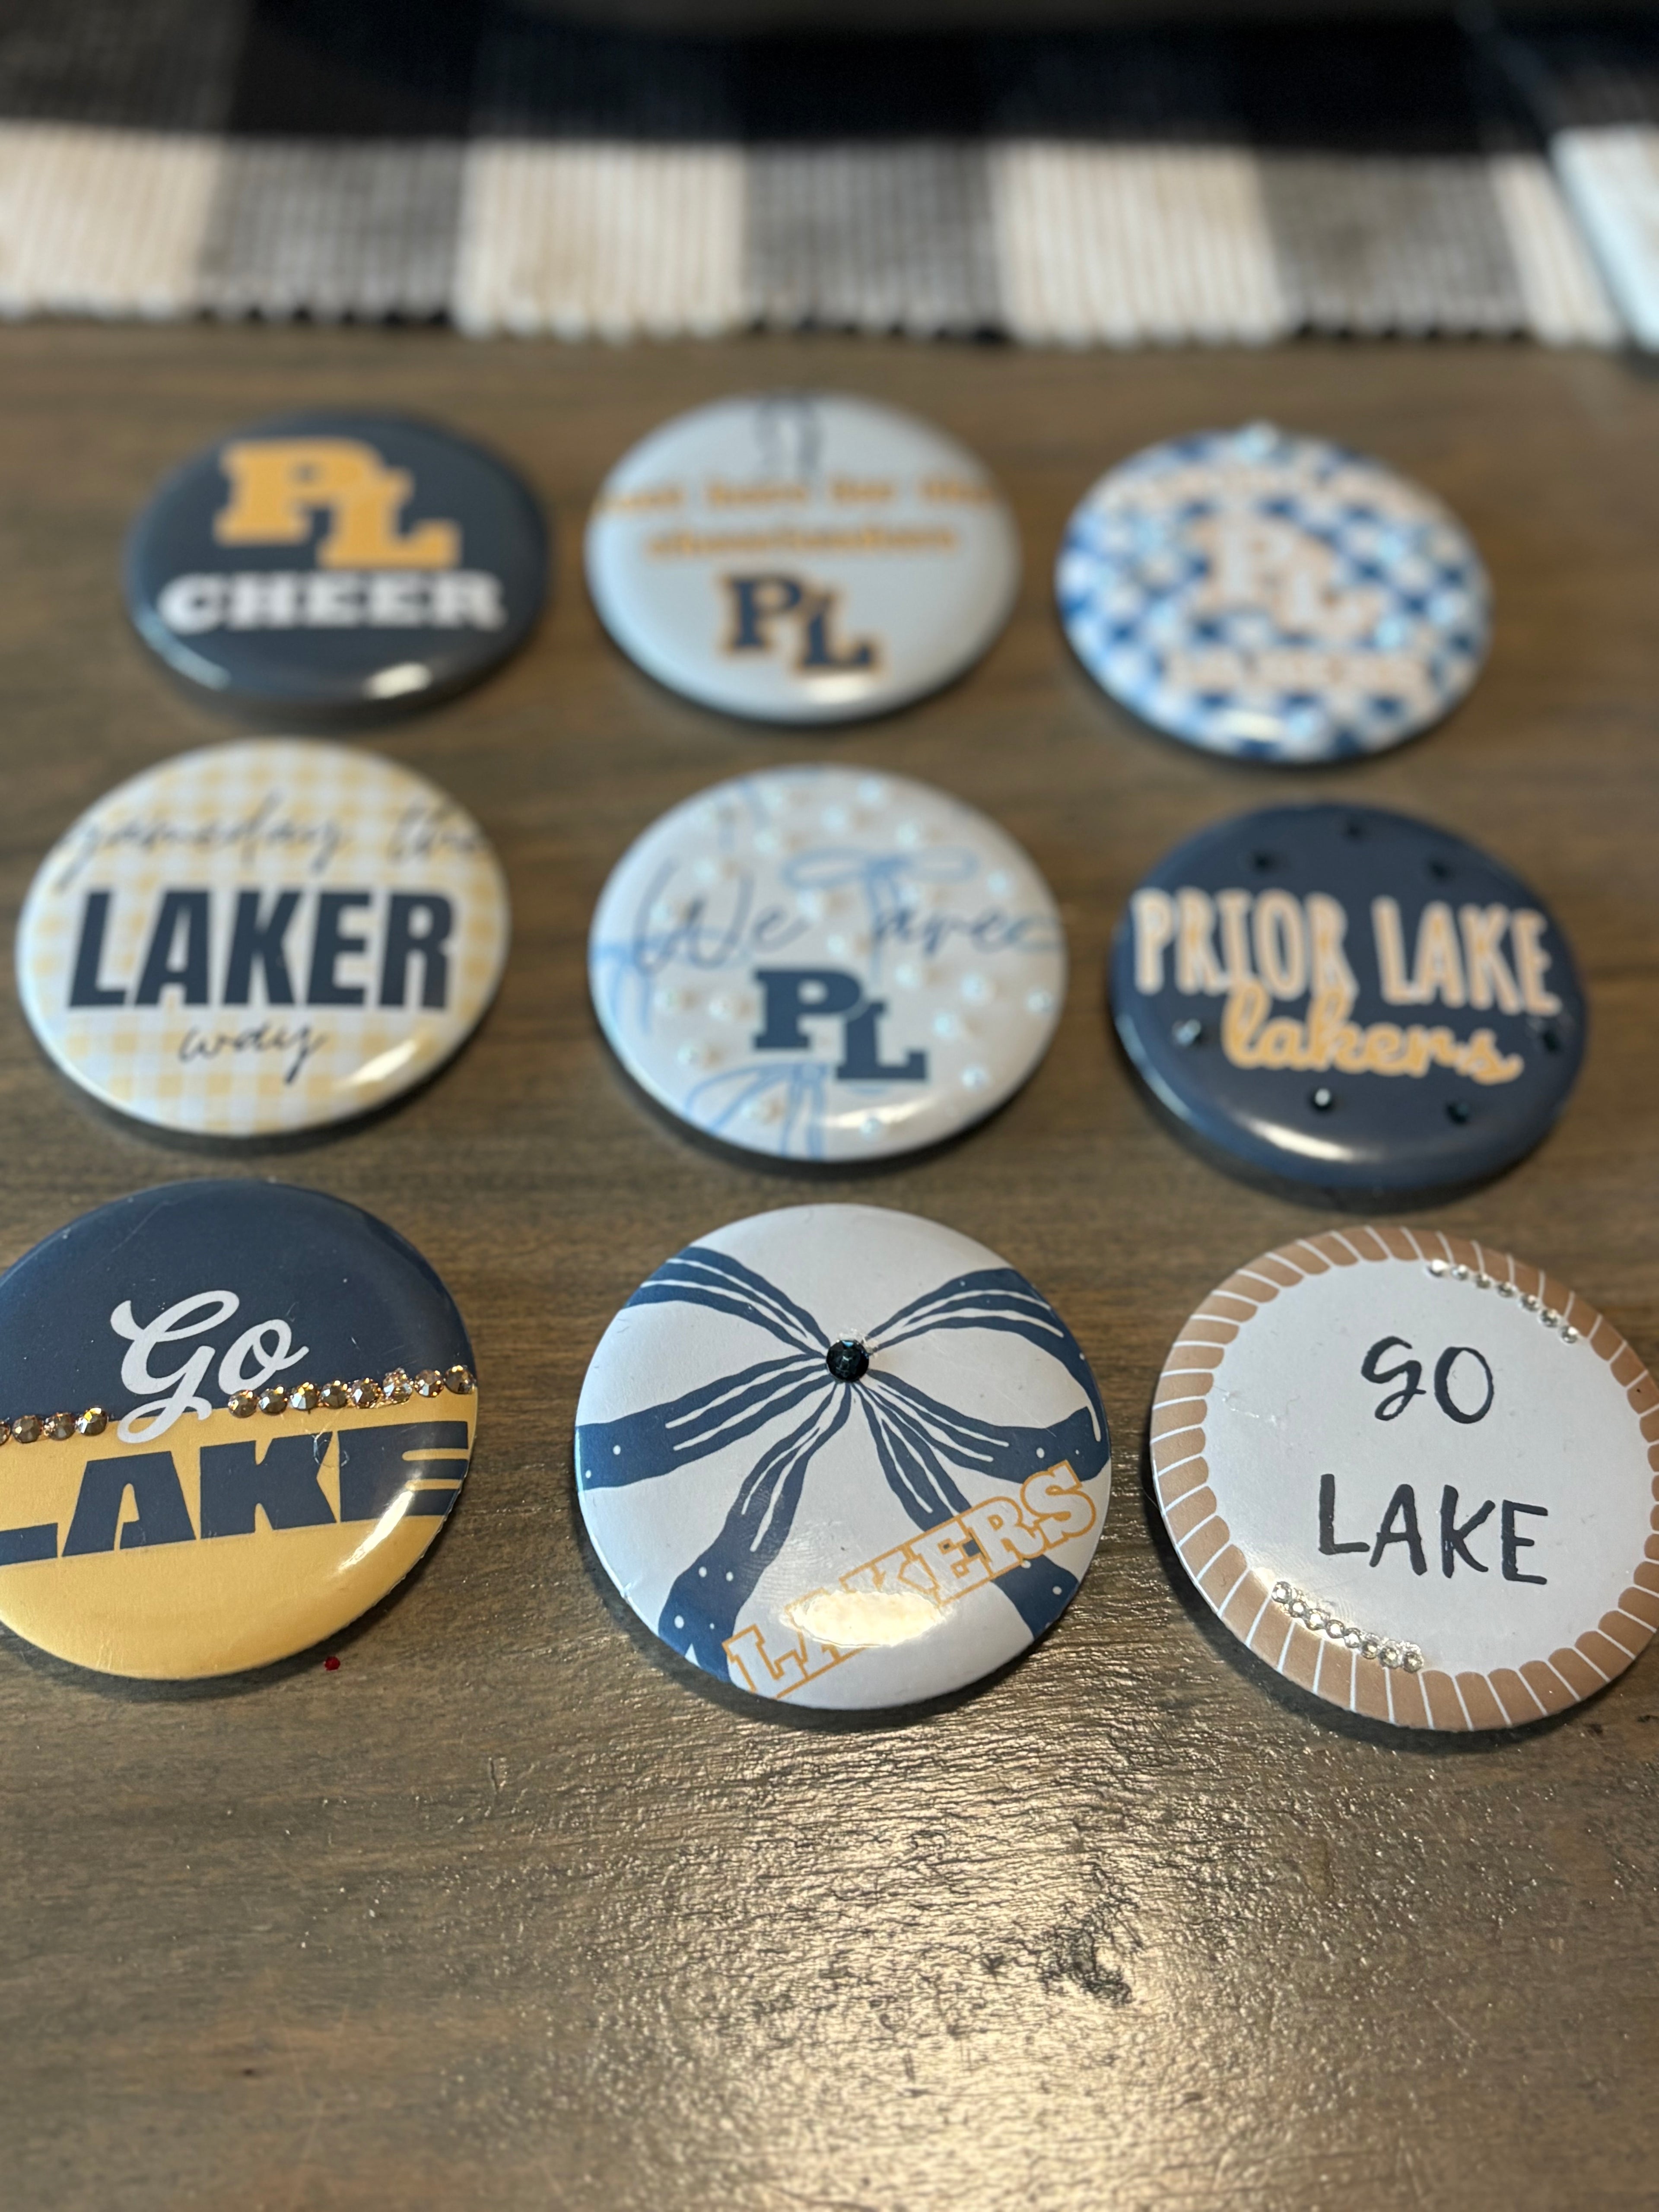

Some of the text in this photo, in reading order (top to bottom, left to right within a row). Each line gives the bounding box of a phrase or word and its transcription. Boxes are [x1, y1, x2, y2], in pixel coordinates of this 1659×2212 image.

[215, 438, 461, 569] PL
[158, 571, 507, 634] CHEER
[721, 571, 882, 676] PL
[68, 889, 455, 1010] LAKER
[632, 856, 814, 975] We
[1130, 887, 1561, 1016] PRIOR LAKE
[179, 1020, 331, 1085] way
[752, 967, 927, 1080] PL
[1221, 977, 1525, 1086] lakers
[110, 1290, 309, 1443] Go
[1318, 1473, 1548, 1585] LAKE
